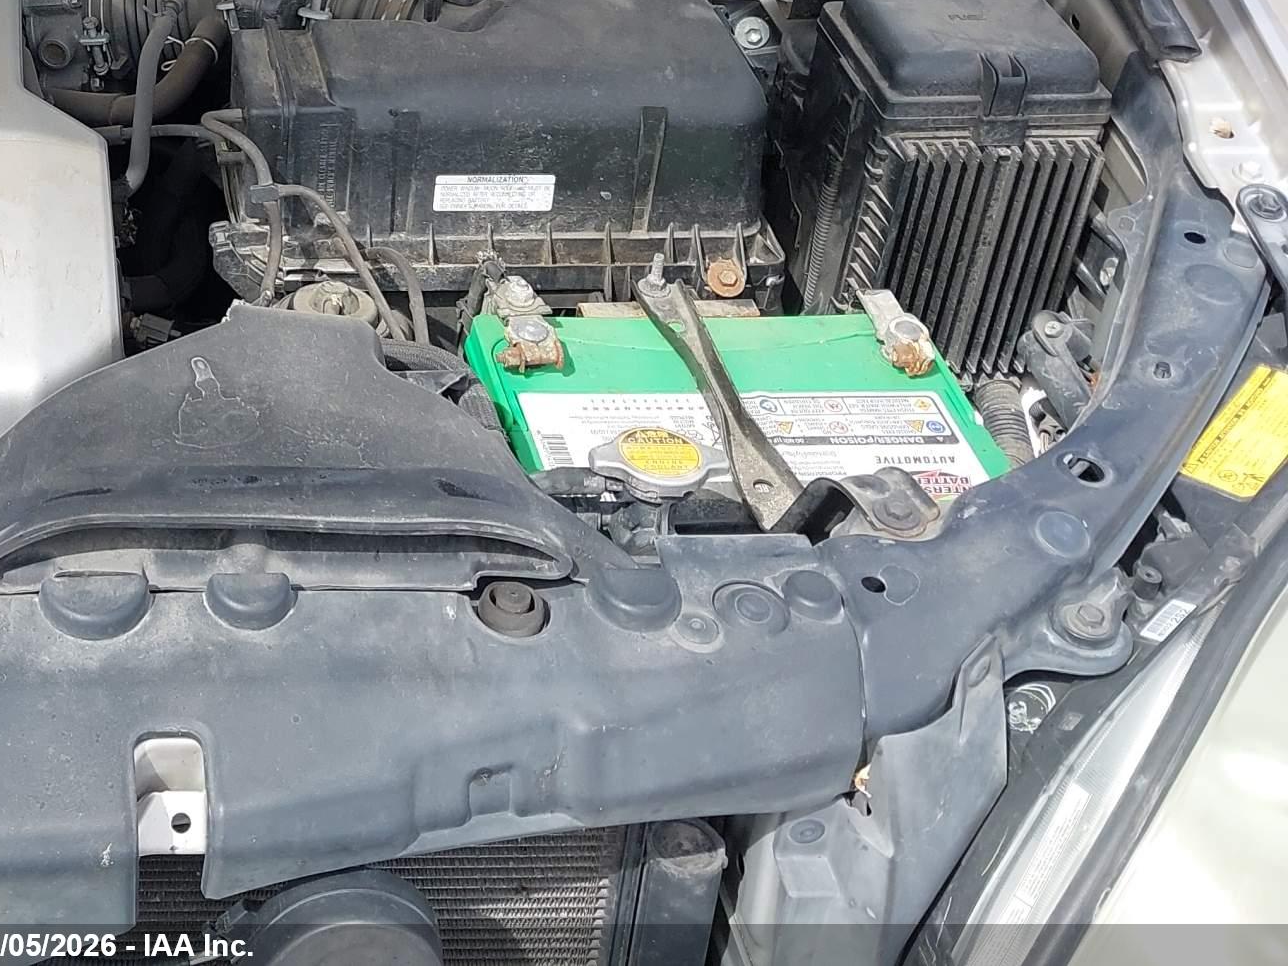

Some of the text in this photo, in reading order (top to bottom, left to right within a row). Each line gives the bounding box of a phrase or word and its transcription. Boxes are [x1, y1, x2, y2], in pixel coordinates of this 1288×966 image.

[627, 436, 684, 444] CAUTION
[829, 436, 925, 445] DANGER/POISON
[874, 455, 956, 465] AUTOMOTIVE
